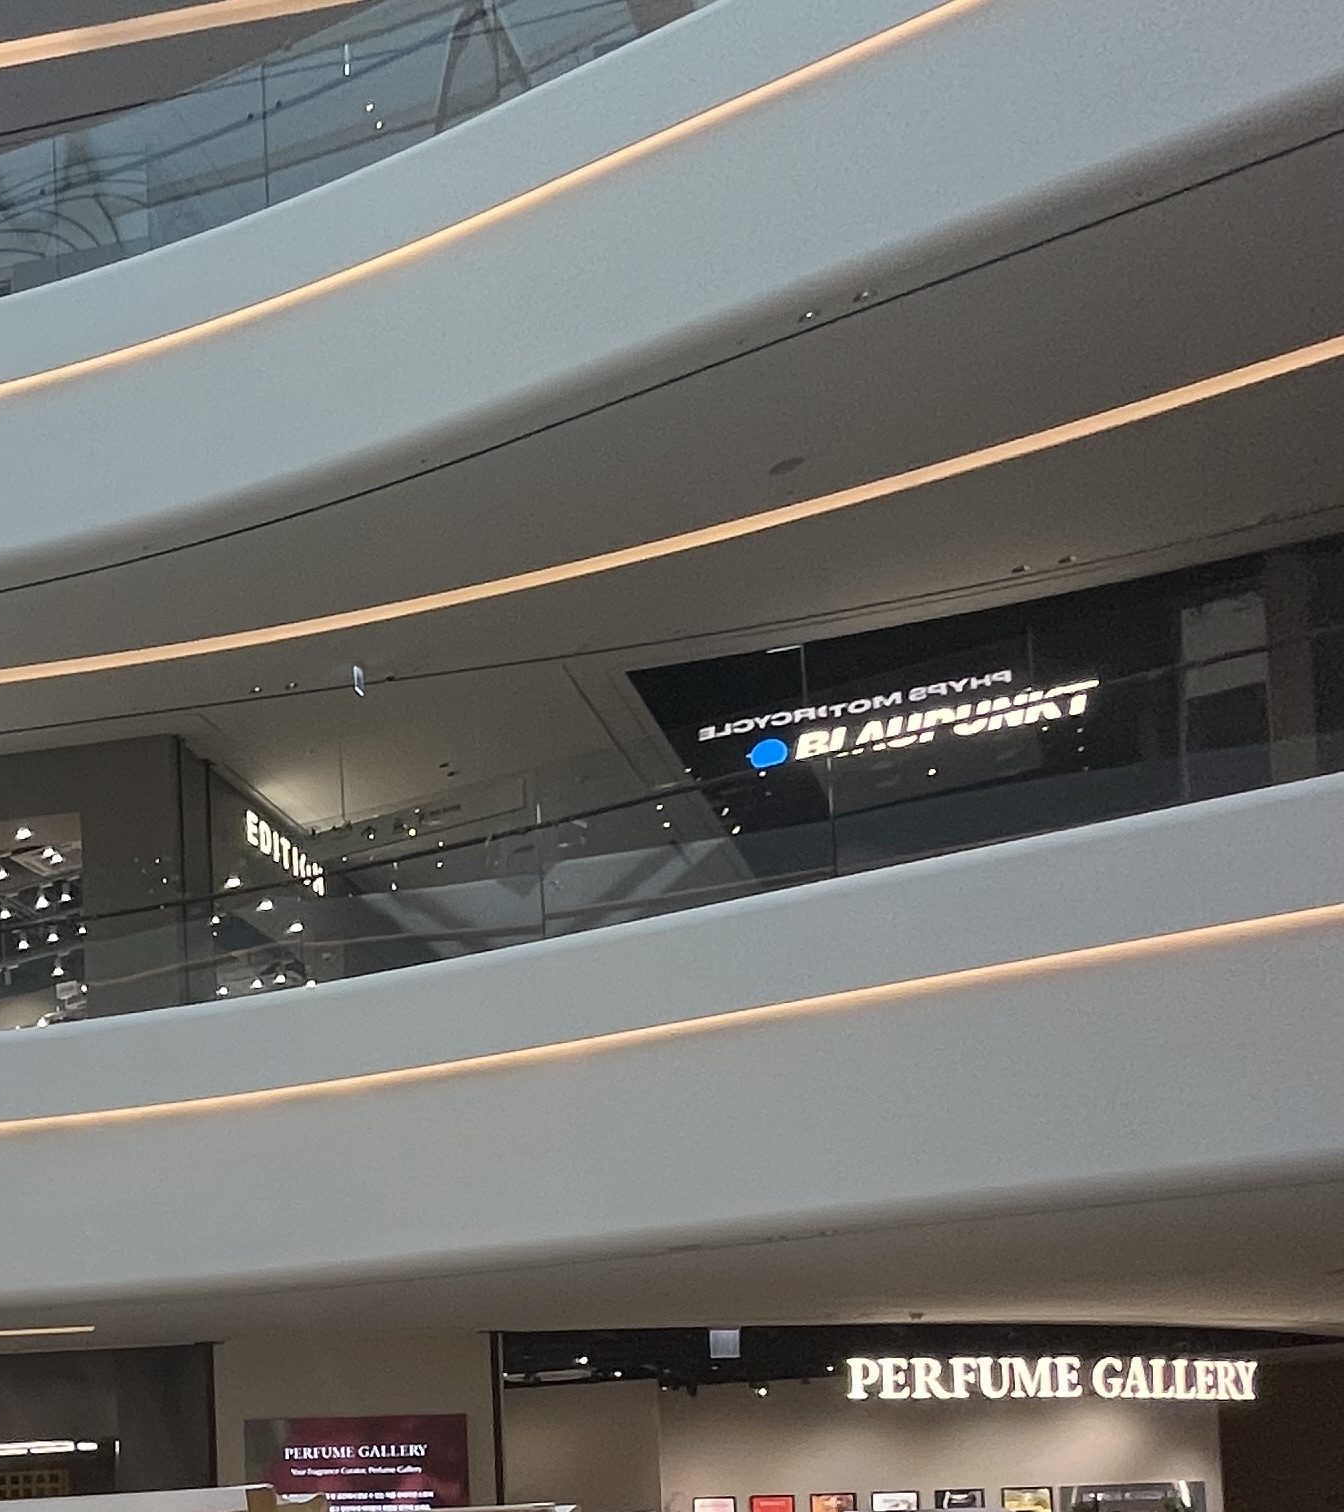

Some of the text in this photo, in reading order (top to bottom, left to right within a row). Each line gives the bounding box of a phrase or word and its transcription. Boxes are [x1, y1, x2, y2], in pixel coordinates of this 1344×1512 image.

[793, 678, 1100, 761] BLAUPUNKT
[246, 809, 325, 897] EDITION
[846, 1356, 1258, 1400] PERFUME GALLERY
[284, 1444, 428, 1460] PERFUME GALLERY
